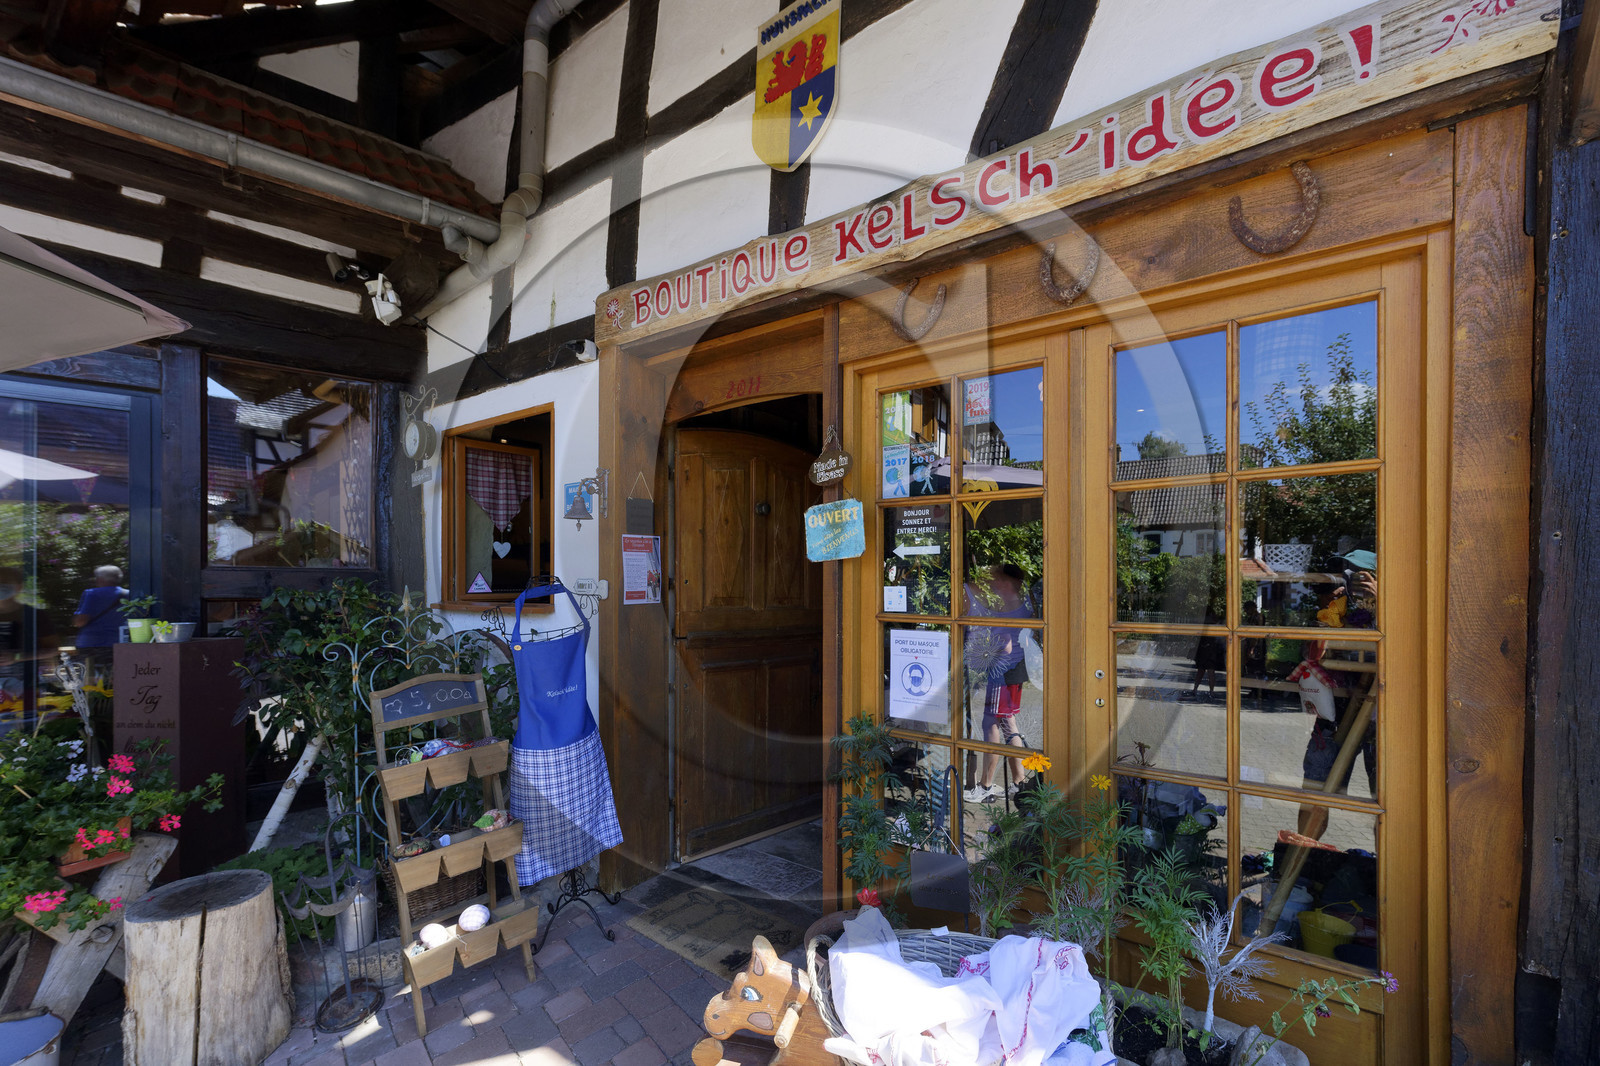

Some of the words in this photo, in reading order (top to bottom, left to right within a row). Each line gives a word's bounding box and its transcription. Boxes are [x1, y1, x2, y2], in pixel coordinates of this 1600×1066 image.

[760, 0, 831, 45] HUNSPAC
[726, 376, 761, 399] 2011
[968, 381, 989, 394] 2019
[813, 458, 837, 474] Made
[838, 455, 849, 467] in
[885, 457, 907, 467] 2017
[912, 454, 935, 464] 2018
[816, 468, 845, 484] Elsass
[808, 506, 860, 529] OUVERT
[903, 508, 930, 517] BONJOUR
[902, 518, 923, 526] SONNEZ
[896, 527, 917, 535] ENTREZ
[917, 526, 937, 534] MERCI!
[900, 647, 934, 656] OBLIGATOIRE
[131, 661, 161, 680] Jeder
[129, 685, 162, 714] Tag
[116, 721, 126, 729] an
[127, 719, 144, 729] dem
[145, 719, 155, 729] du
[156, 718, 176, 729] nicht
